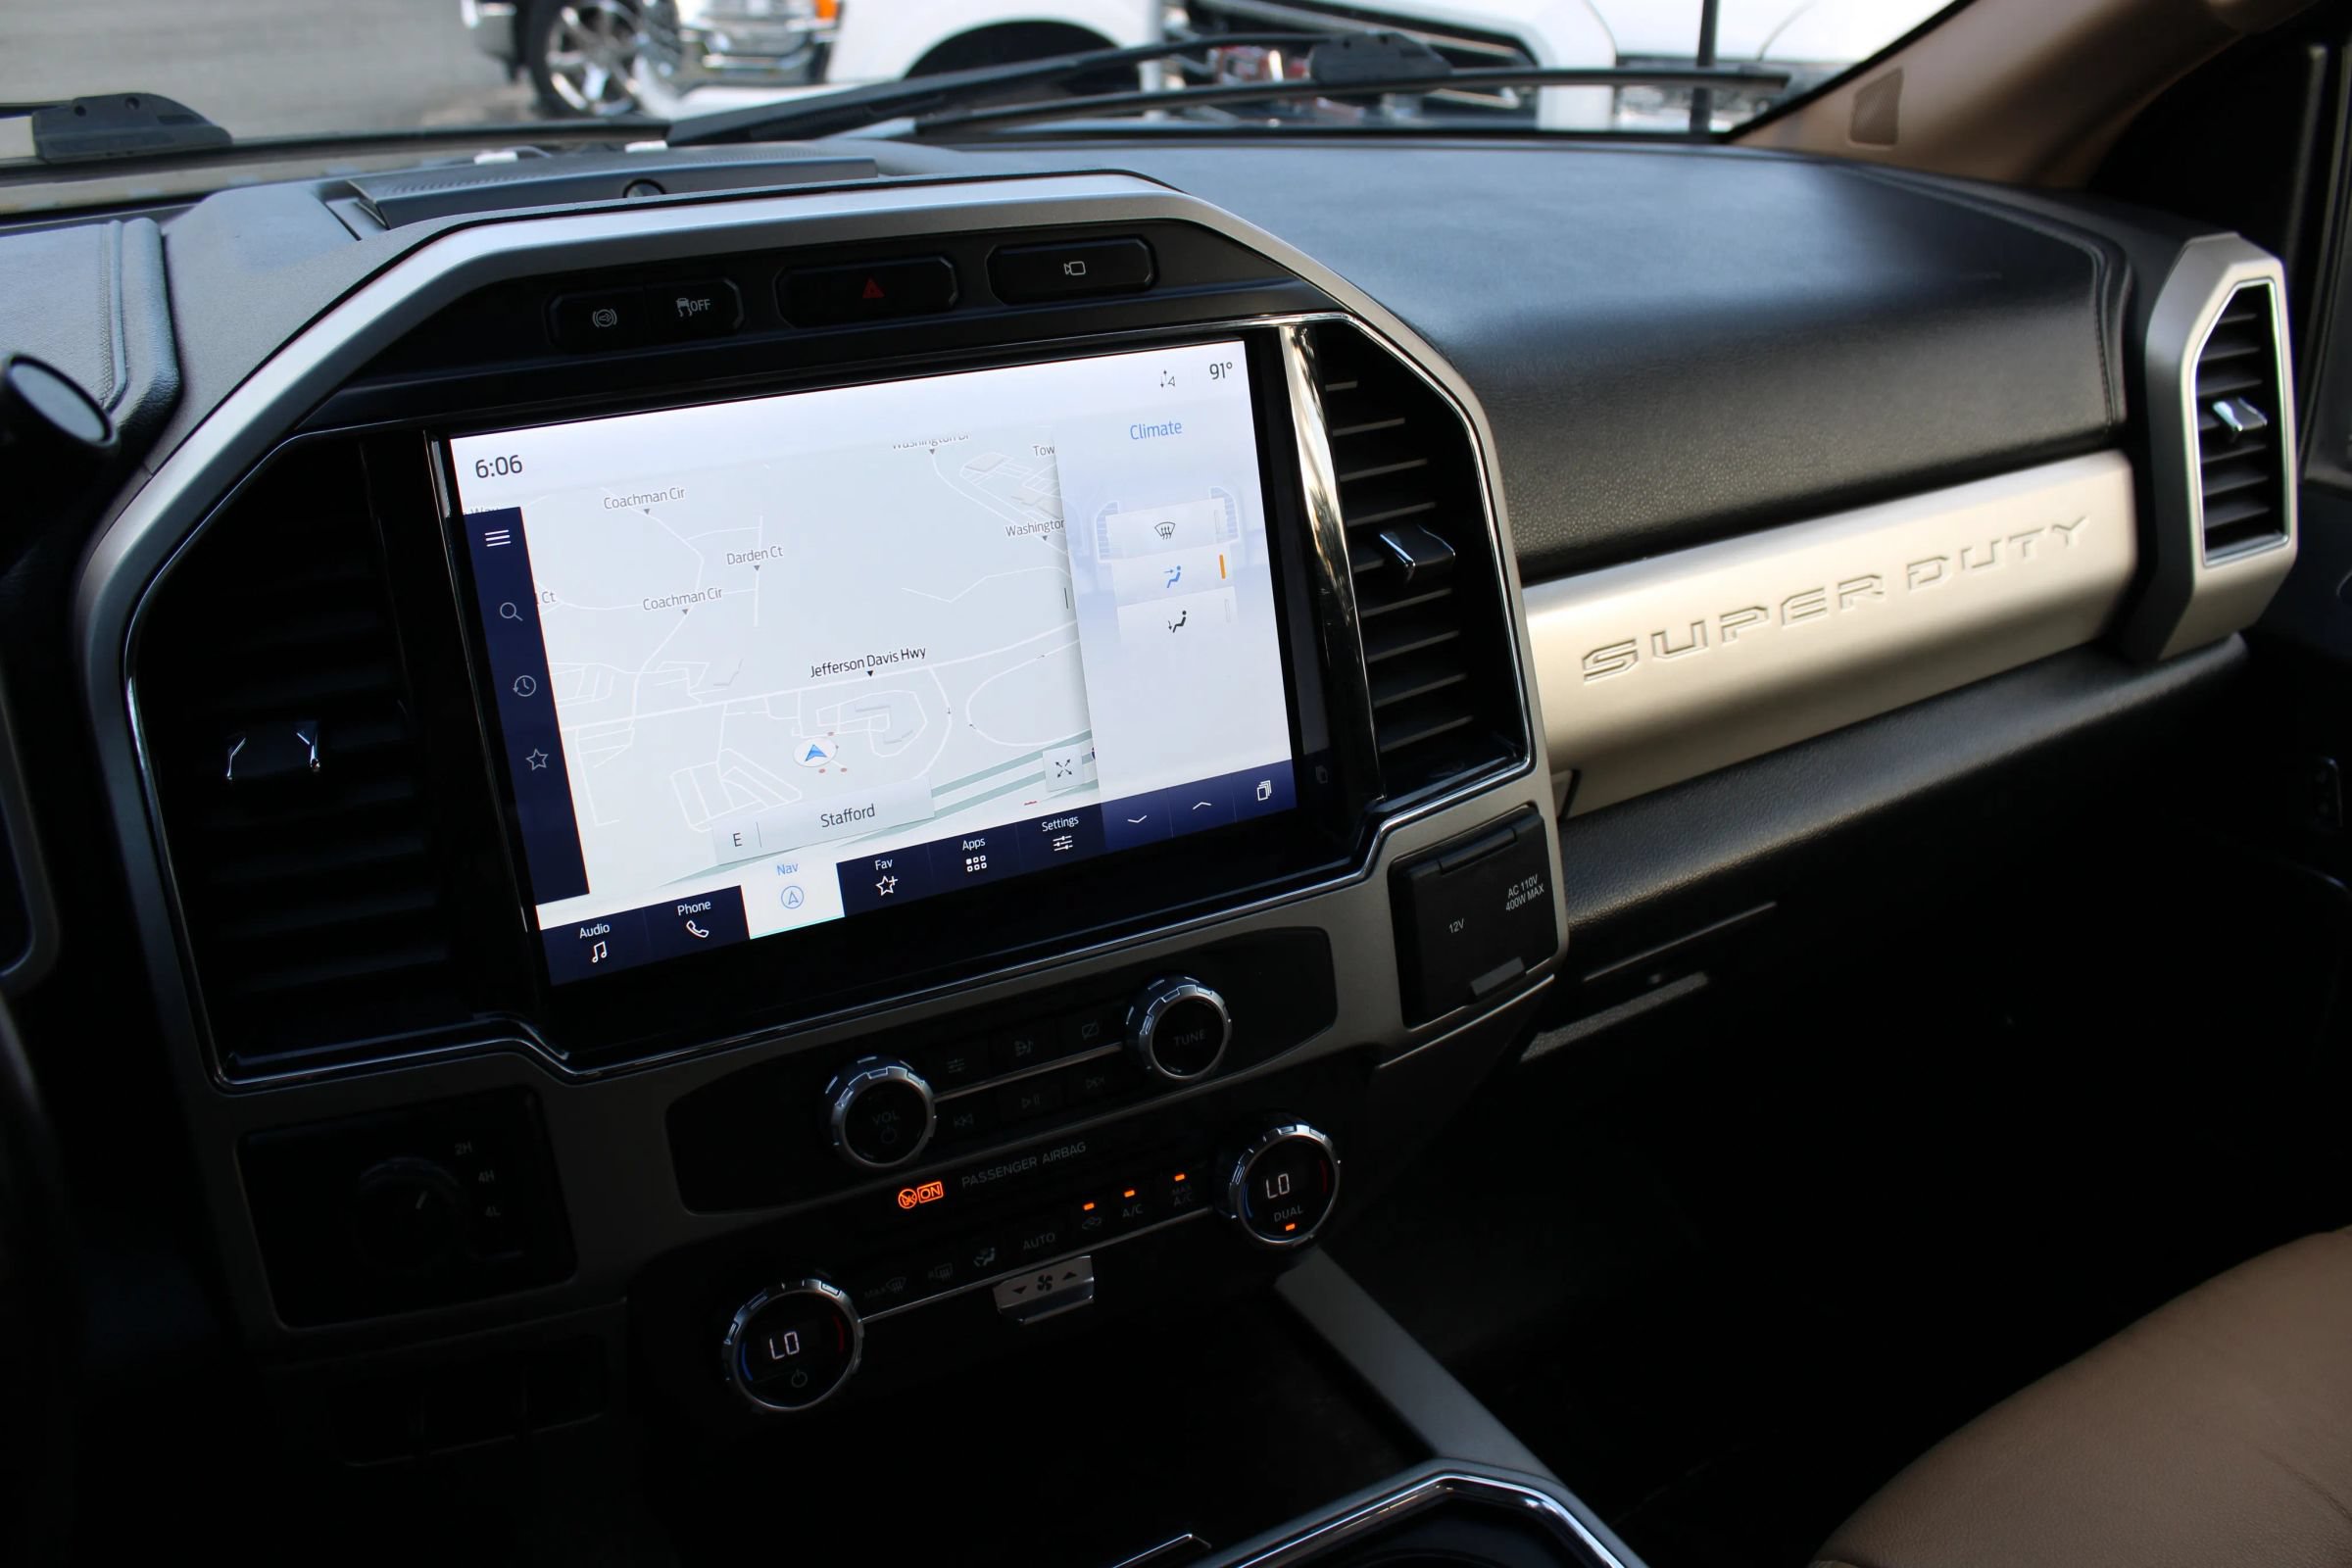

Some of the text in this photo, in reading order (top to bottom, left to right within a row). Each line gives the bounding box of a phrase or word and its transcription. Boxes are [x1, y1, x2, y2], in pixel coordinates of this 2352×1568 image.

[691, 299, 711, 312] OFF
[1209, 362, 1233, 380] 91°
[1130, 420, 1183, 440] Climate
[475, 455, 522, 478] 6:06
[604, 487, 685, 510] Coachman Cir
[727, 546, 784, 565] Darden Ct
[541, 591, 557, 604] Ct
[643, 587, 722, 610] Coachman Cir
[1582, 515, 2090, 684] SUPER DUTY
[810, 647, 926, 677] Jefferson Davis Hwy
[820, 804, 875, 828] Stafford
[1042, 813, 1079, 832] Settings
[732, 832, 743, 847] E
[962, 837, 986, 853] Apps
[777, 862, 799, 876] Nav
[875, 858, 893, 870] Fav
[1508, 873, 1539, 899] AC 110V
[1505, 883, 1544, 911] 400W MAX
[677, 900, 711, 916] Phone
[579, 922, 611, 939] Audio
[1449, 918, 1465, 933] 12V
[1173, 1029, 1206, 1047] TUNE
[961, 1141, 1087, 1189] PASSENGER AIRBAG
[919, 1185, 941, 1201] ON
[1122, 1203, 1144, 1219] A/C
[1274, 1204, 1304, 1223] DUAL
[1022, 1231, 1056, 1250] AUTO
